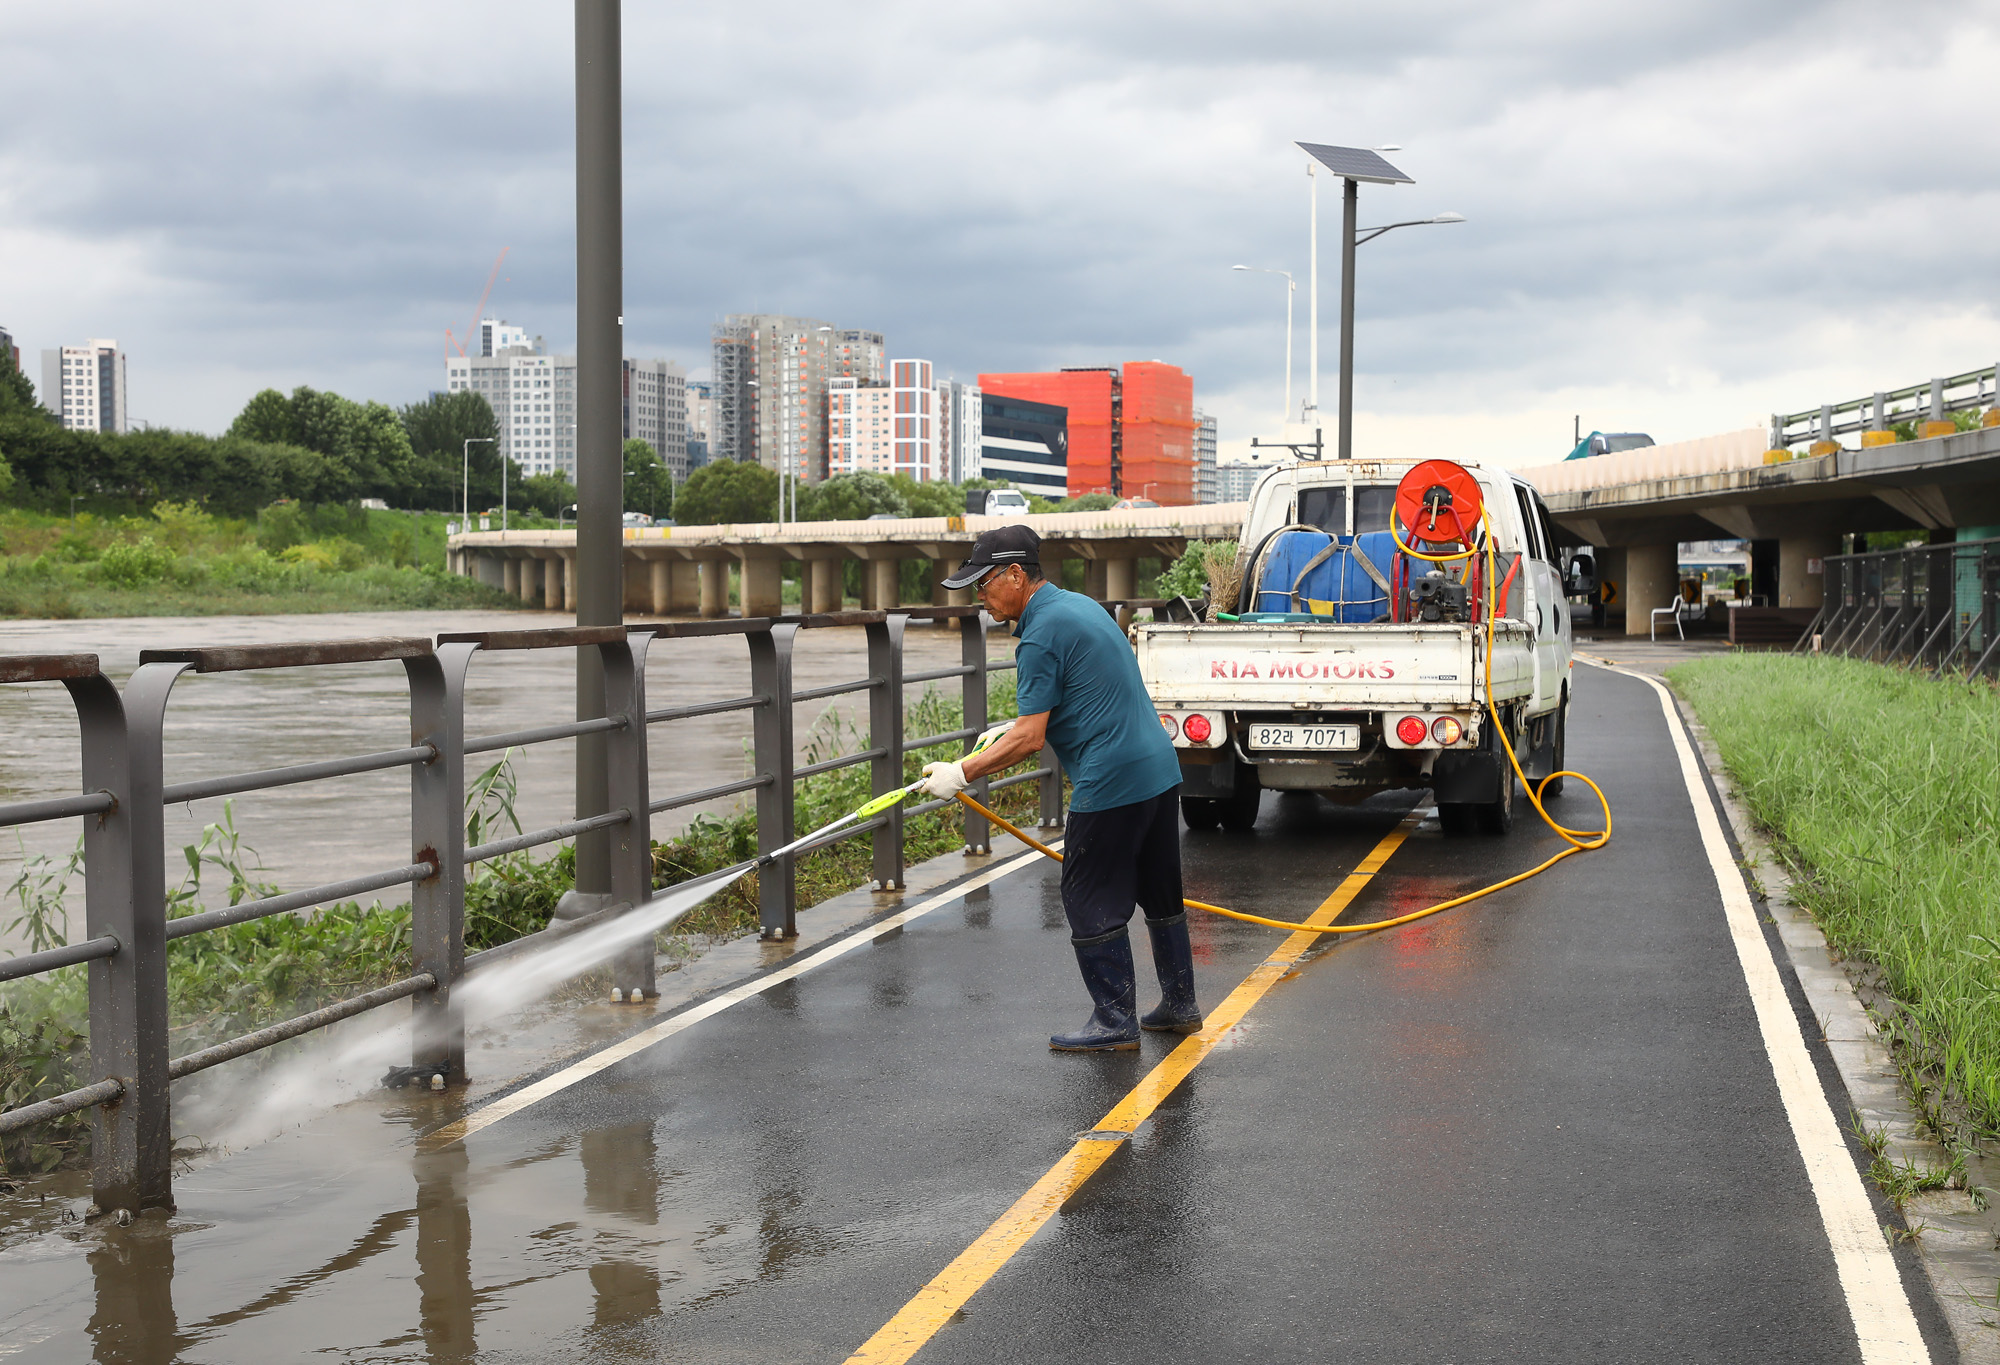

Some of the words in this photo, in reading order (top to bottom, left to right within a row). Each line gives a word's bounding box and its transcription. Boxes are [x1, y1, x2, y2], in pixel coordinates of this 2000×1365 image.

[1211, 660, 1260, 678] KIA
[1269, 660, 1395, 679] MOTORS
[1260, 729, 1294, 745] 82라
[1303, 729, 1347, 746] 7071
